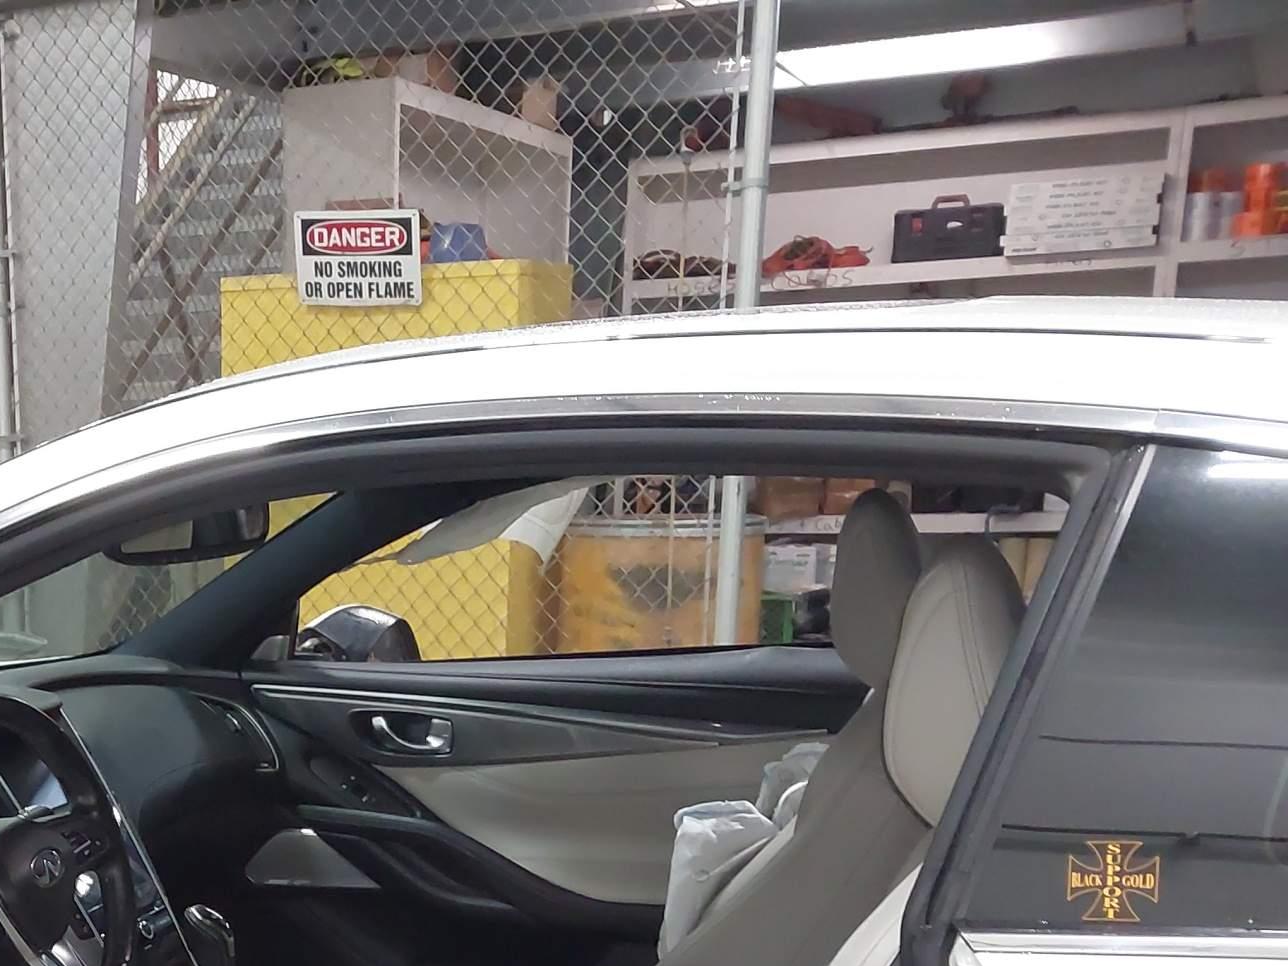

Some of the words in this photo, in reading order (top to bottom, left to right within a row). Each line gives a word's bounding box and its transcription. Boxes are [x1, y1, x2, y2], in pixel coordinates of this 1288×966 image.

[313, 226, 401, 248] DANGER
[313, 260, 333, 278] NO
[337, 260, 402, 278] SMOKING
[305, 281, 323, 298] OR
[327, 281, 363, 298] OPEN
[368, 281, 415, 298] FLAME
[1071, 871, 1103, 888] BLACK
[1122, 873, 1154, 889] GOLD
[1103, 843, 1122, 919] SUPPORT
